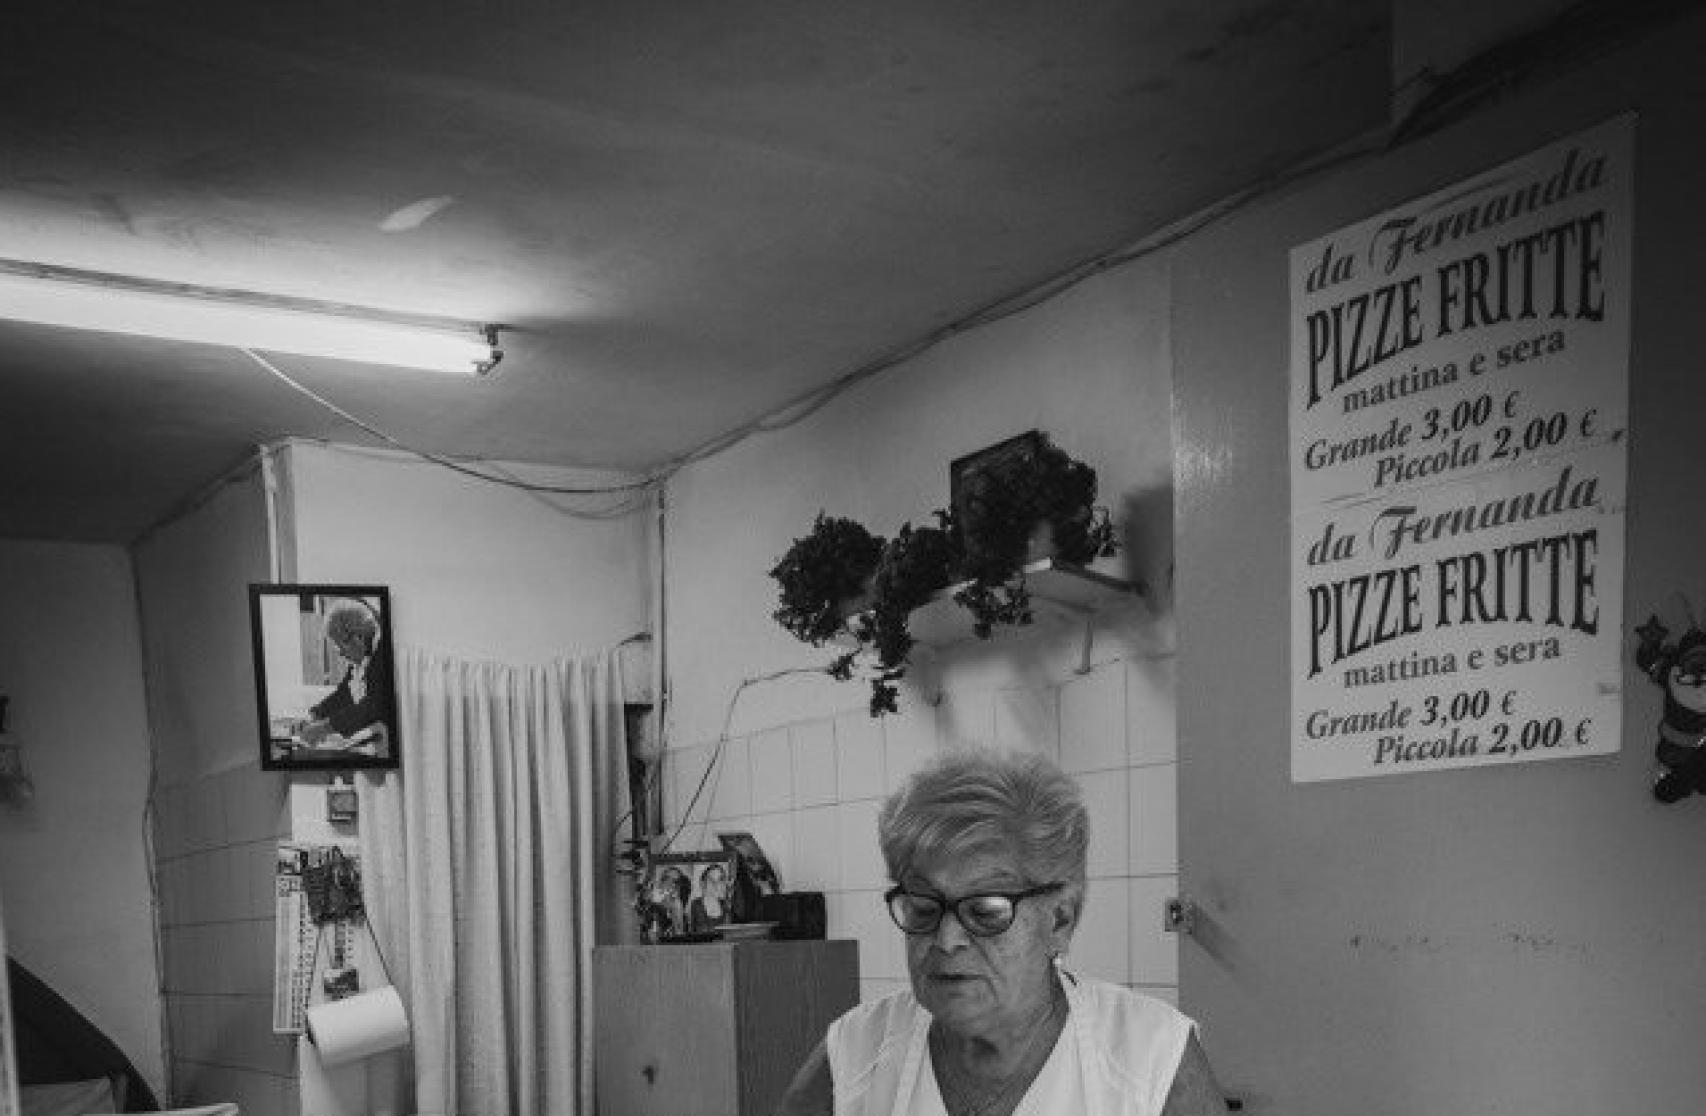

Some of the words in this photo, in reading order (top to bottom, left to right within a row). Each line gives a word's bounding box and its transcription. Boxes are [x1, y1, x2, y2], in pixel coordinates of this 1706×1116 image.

[1306, 244, 1355, 293] da
[1369, 149, 1608, 276] Fernanda
[1306, 275, 1424, 410] PIZZE
[1436, 211, 1606, 338] FRITTE
[1343, 359, 1458, 414] mattina
[1469, 352, 1487, 376] e
[1497, 330, 1566, 369] sera
[1305, 417, 1412, 470] Grande
[1421, 393, 1493, 444] 3,00
[1374, 440, 1480, 488] Piccola
[1489, 411, 1568, 461] 2,00
[1306, 522, 1355, 566] da
[1369, 465, 1600, 560] Fernanda
[1307, 564, 1424, 680] PIZZE
[1436, 529, 1600, 636] FRITTE
[1343, 650, 1458, 688] mattina
[1467, 648, 1485, 670] e
[1494, 637, 1561, 668] sera
[1305, 700, 1412, 740] Grande
[1419, 688, 1491, 728] 3,00
[1374, 727, 1480, 765] Piccola
[1488, 716, 1564, 758] 2,00
